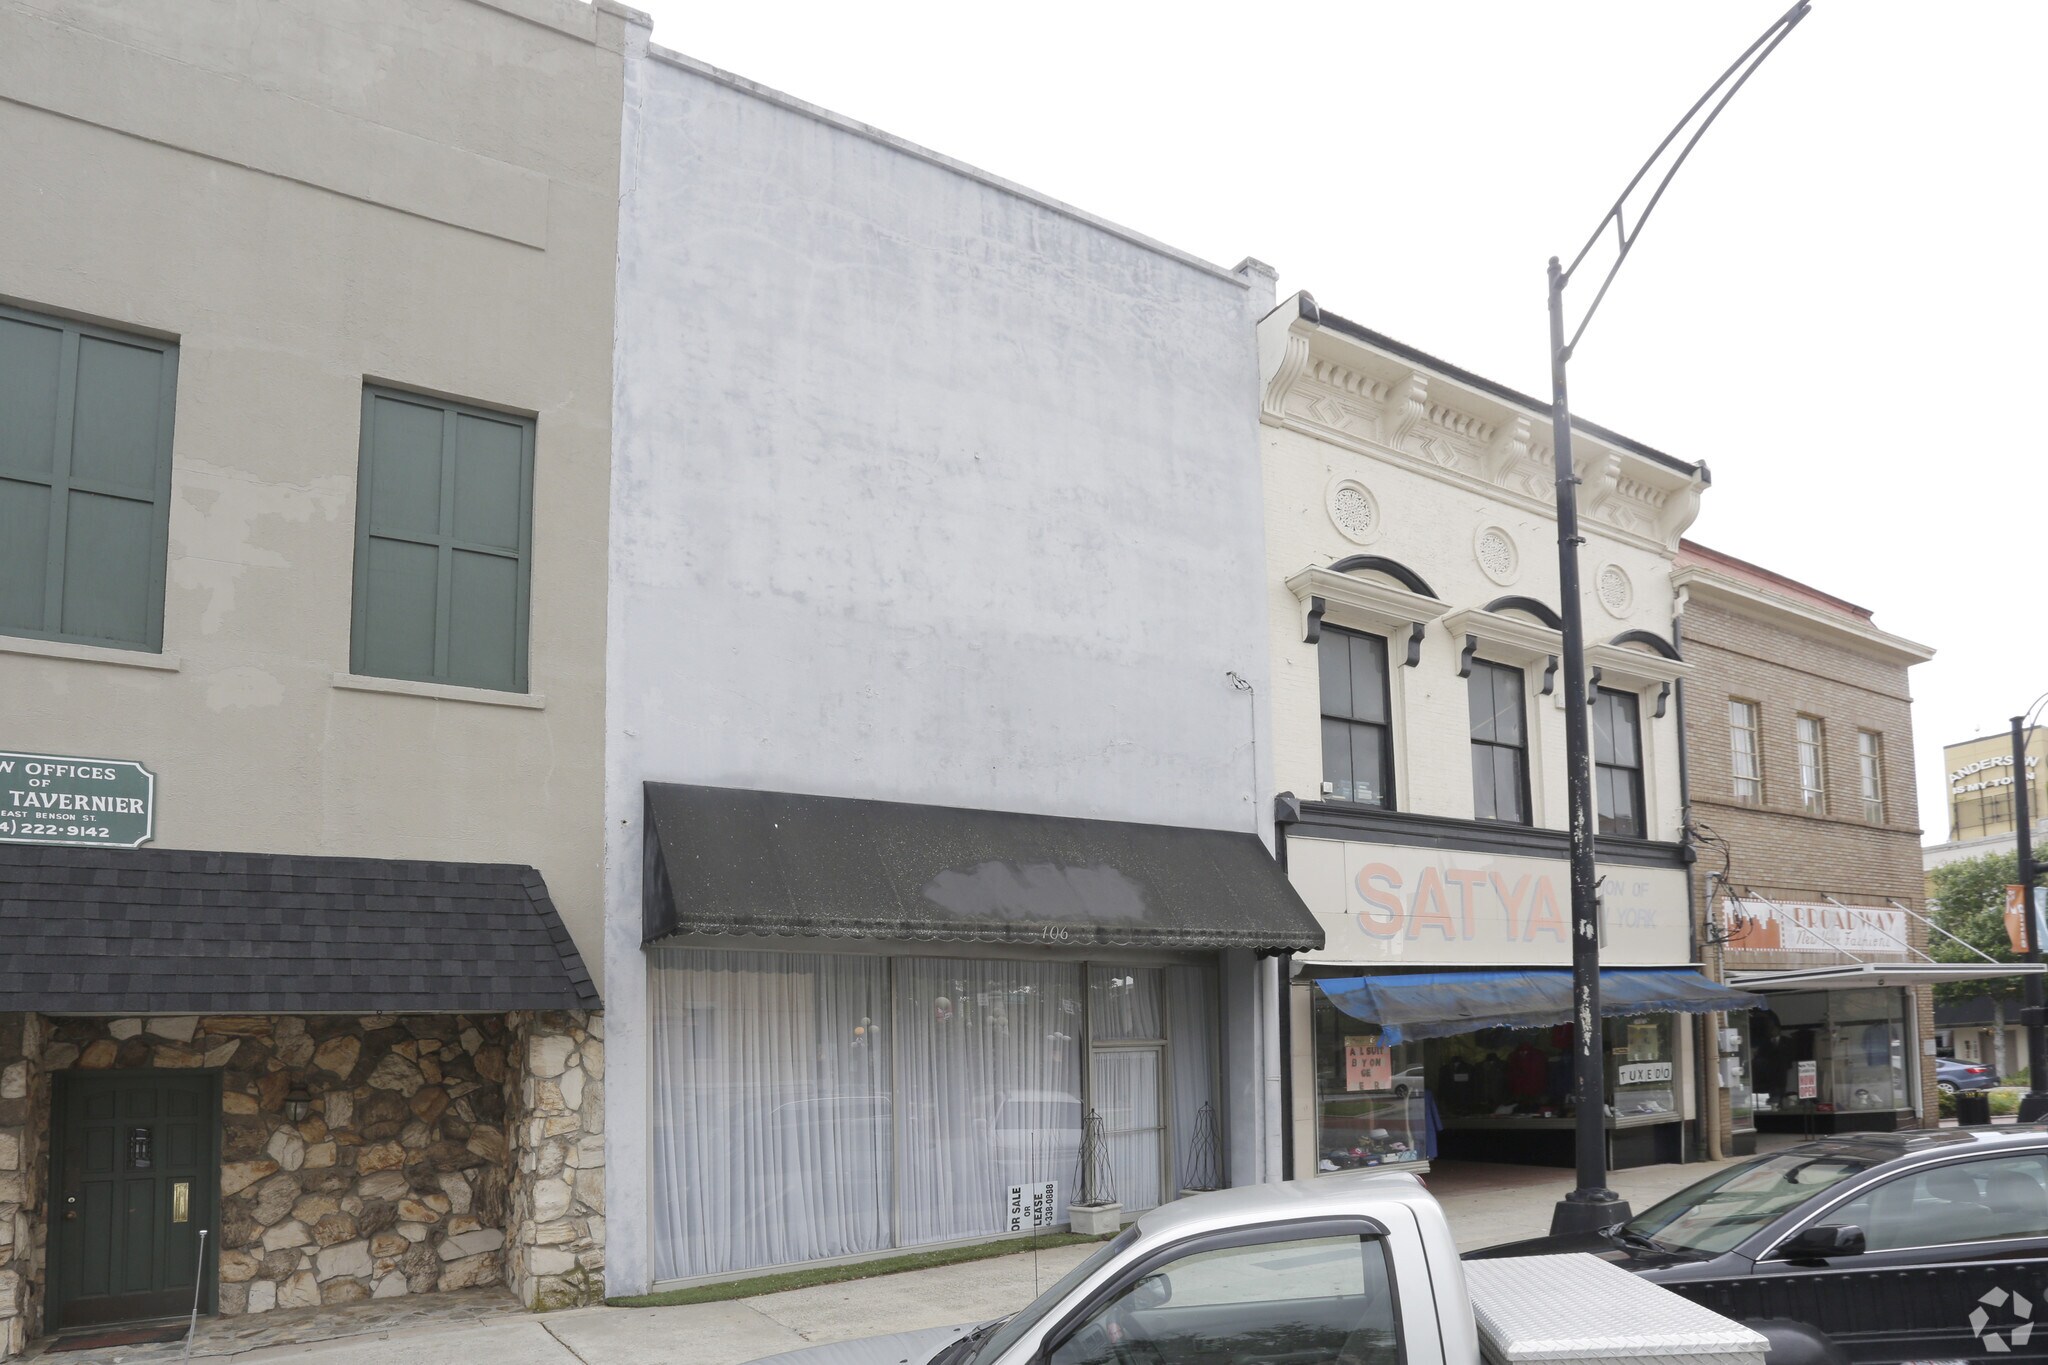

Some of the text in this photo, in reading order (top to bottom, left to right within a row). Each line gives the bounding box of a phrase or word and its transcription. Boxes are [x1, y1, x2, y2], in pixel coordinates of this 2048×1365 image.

[25, 763, 116, 780] OFFICES
[1949, 755, 2039, 784] ANDERSN
[29, 778, 51, 788] OF
[1993, 771, 2035, 787] TON
[9, 790, 145, 815] TAVERNIER
[1, 810, 97, 822] EAST BENSON ST.
[1355, 862, 1569, 943] SATYA
[1793, 907, 1896, 931] BROADWAY
[1042, 925, 1068, 940] 106
[1621, 1069, 1669, 1081] TUXEDO
[1011, 1187, 1021, 1214] SALE
[1024, 1206, 1031, 1217] OR
[1033, 1193, 1043, 1226] LEASE
